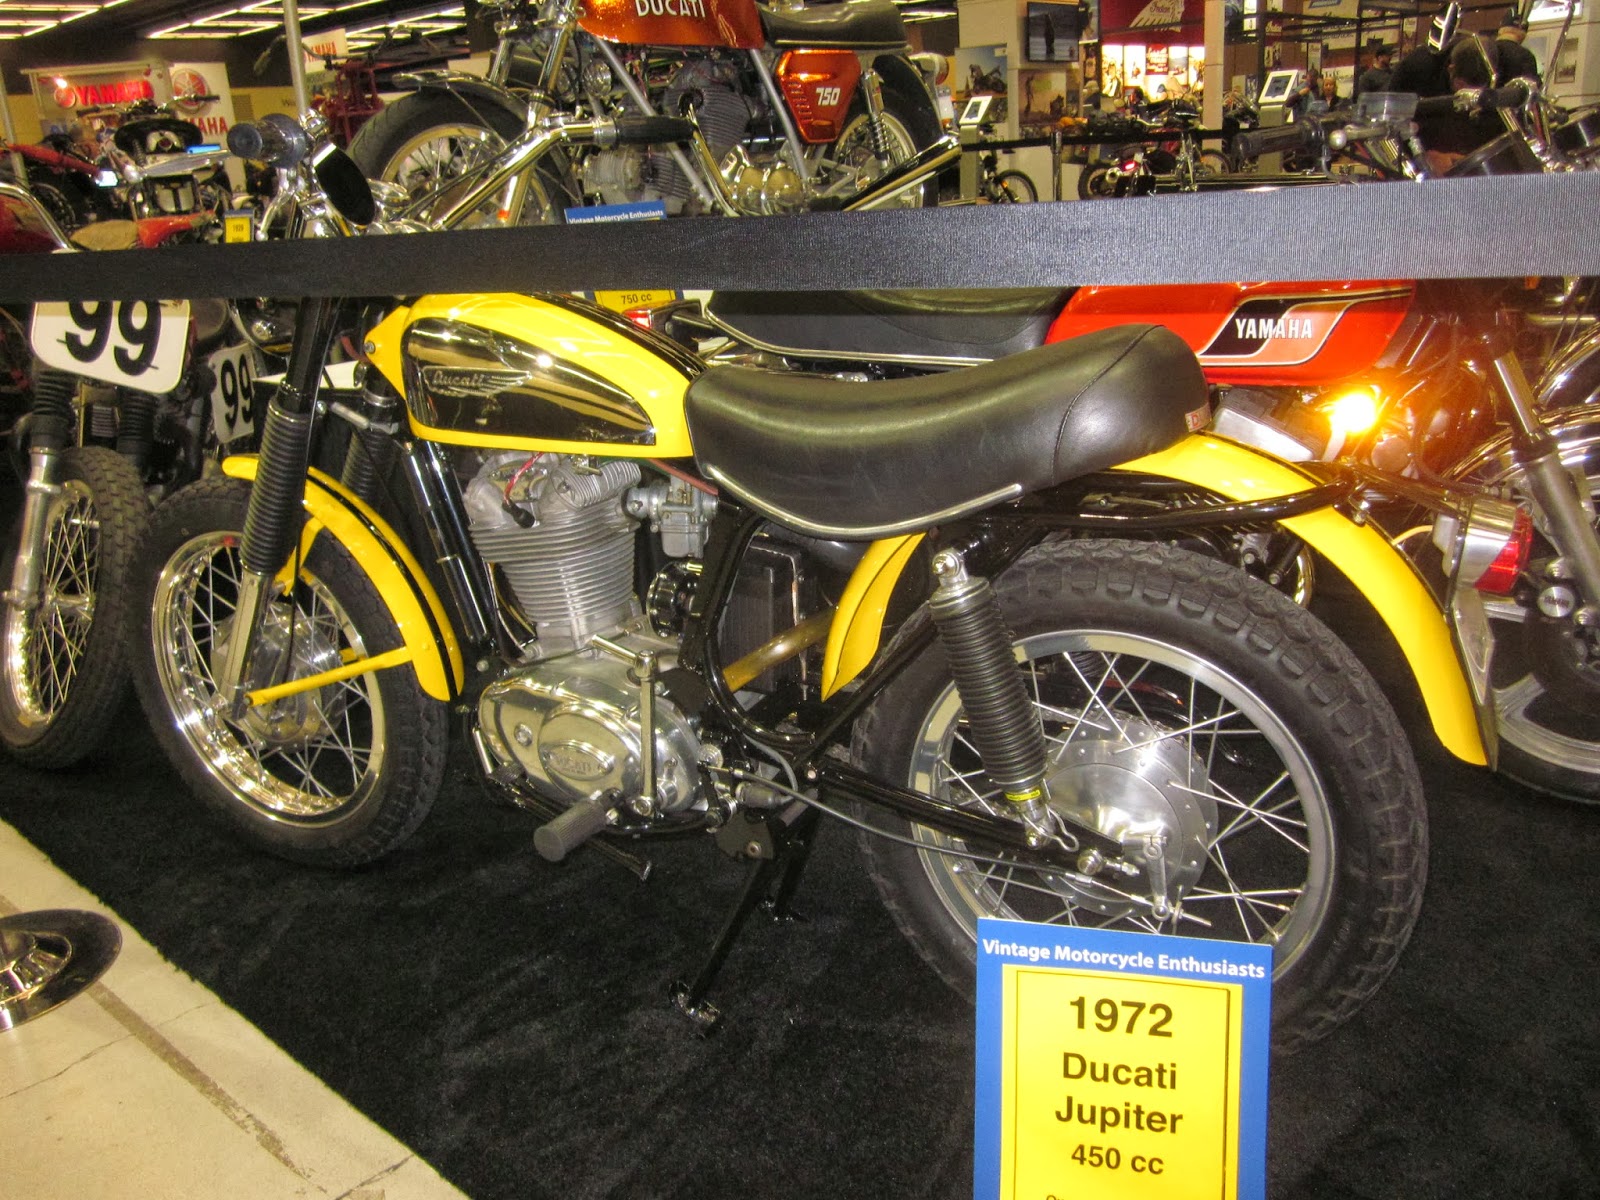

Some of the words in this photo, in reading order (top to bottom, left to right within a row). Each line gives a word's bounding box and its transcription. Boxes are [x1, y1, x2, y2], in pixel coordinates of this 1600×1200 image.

[635, 0, 705, 17] DUCATI
[74, 80, 154, 106] YAMAHA
[816, 87, 841, 106] 750
[594, 213, 629, 222] Motorcycle
[629, 210, 664, 219] Enthusiasts
[621, 294, 638, 305] 750
[641, 293, 652, 302] cc
[65, 300, 162, 376] 99
[1235, 318, 1312, 339] YAMAHA
[220, 354, 253, 431] 99
[982, 939, 1050, 962] Vintage
[1054, 945, 1154, 969] Motorcycle
[1158, 955, 1265, 979] Enthusiasts
[1069, 996, 1173, 1038] 1972
[1063, 1052, 1177, 1090] Ducati
[1055, 1096, 1183, 1134] Jupiter
[1071, 1144, 1122, 1170] 450
[1131, 1155, 1164, 1175] cc
